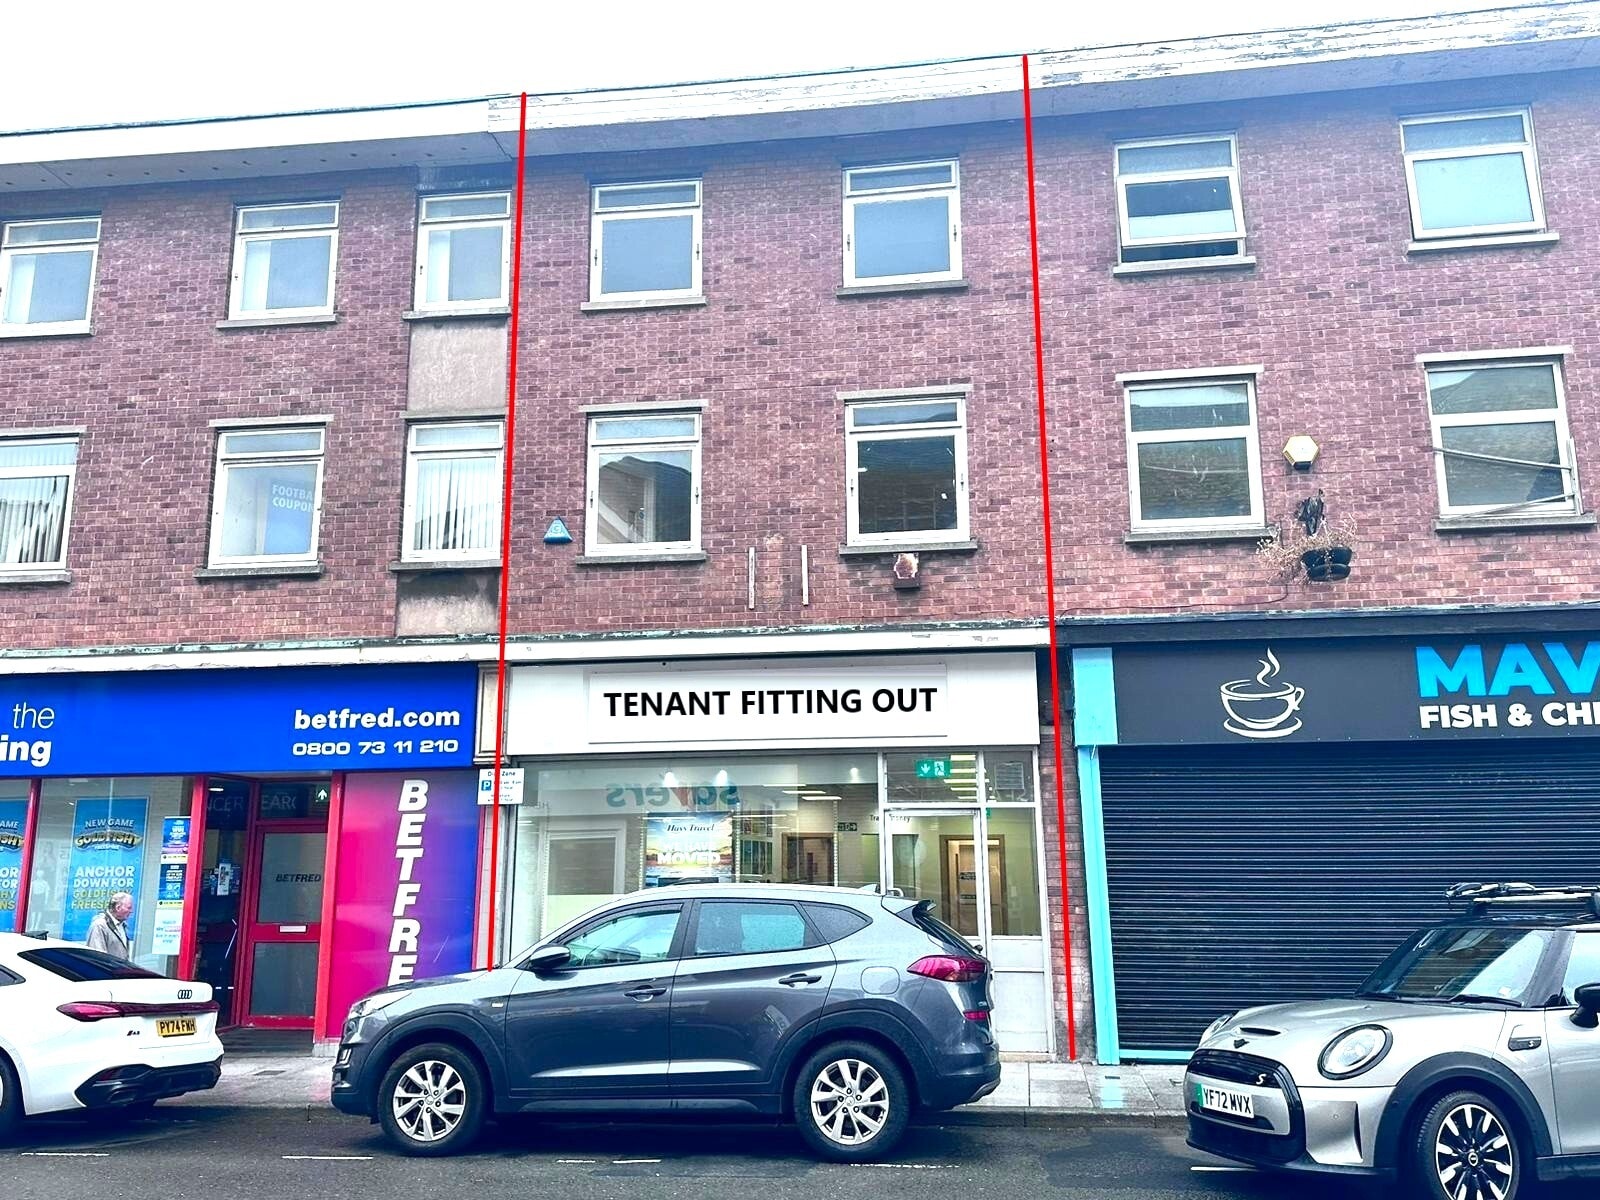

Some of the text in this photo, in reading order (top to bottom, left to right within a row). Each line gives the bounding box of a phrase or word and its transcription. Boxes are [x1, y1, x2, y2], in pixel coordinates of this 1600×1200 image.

[1416, 641, 1600, 698] MAV
[604, 688, 938, 717] TENANT FITTING OUT
[13, 702, 55, 729] the
[294, 707, 460, 730] betfred.com
[1419, 704, 1498, 729] FISH
[1507, 703, 1533, 727] &
[0, 735, 52, 767] ing
[293, 739, 459, 756] 0800 73 11 210
[85, 819, 135, 829] NEW GAME
[657, 851, 721, 865] MOVED
[73, 878, 135, 888] DOWN FOR
[75, 866, 135, 878] ANCHOR
[276, 873, 322, 883] BETFRED
[1203, 1088, 1252, 1115] YF72 MVX
